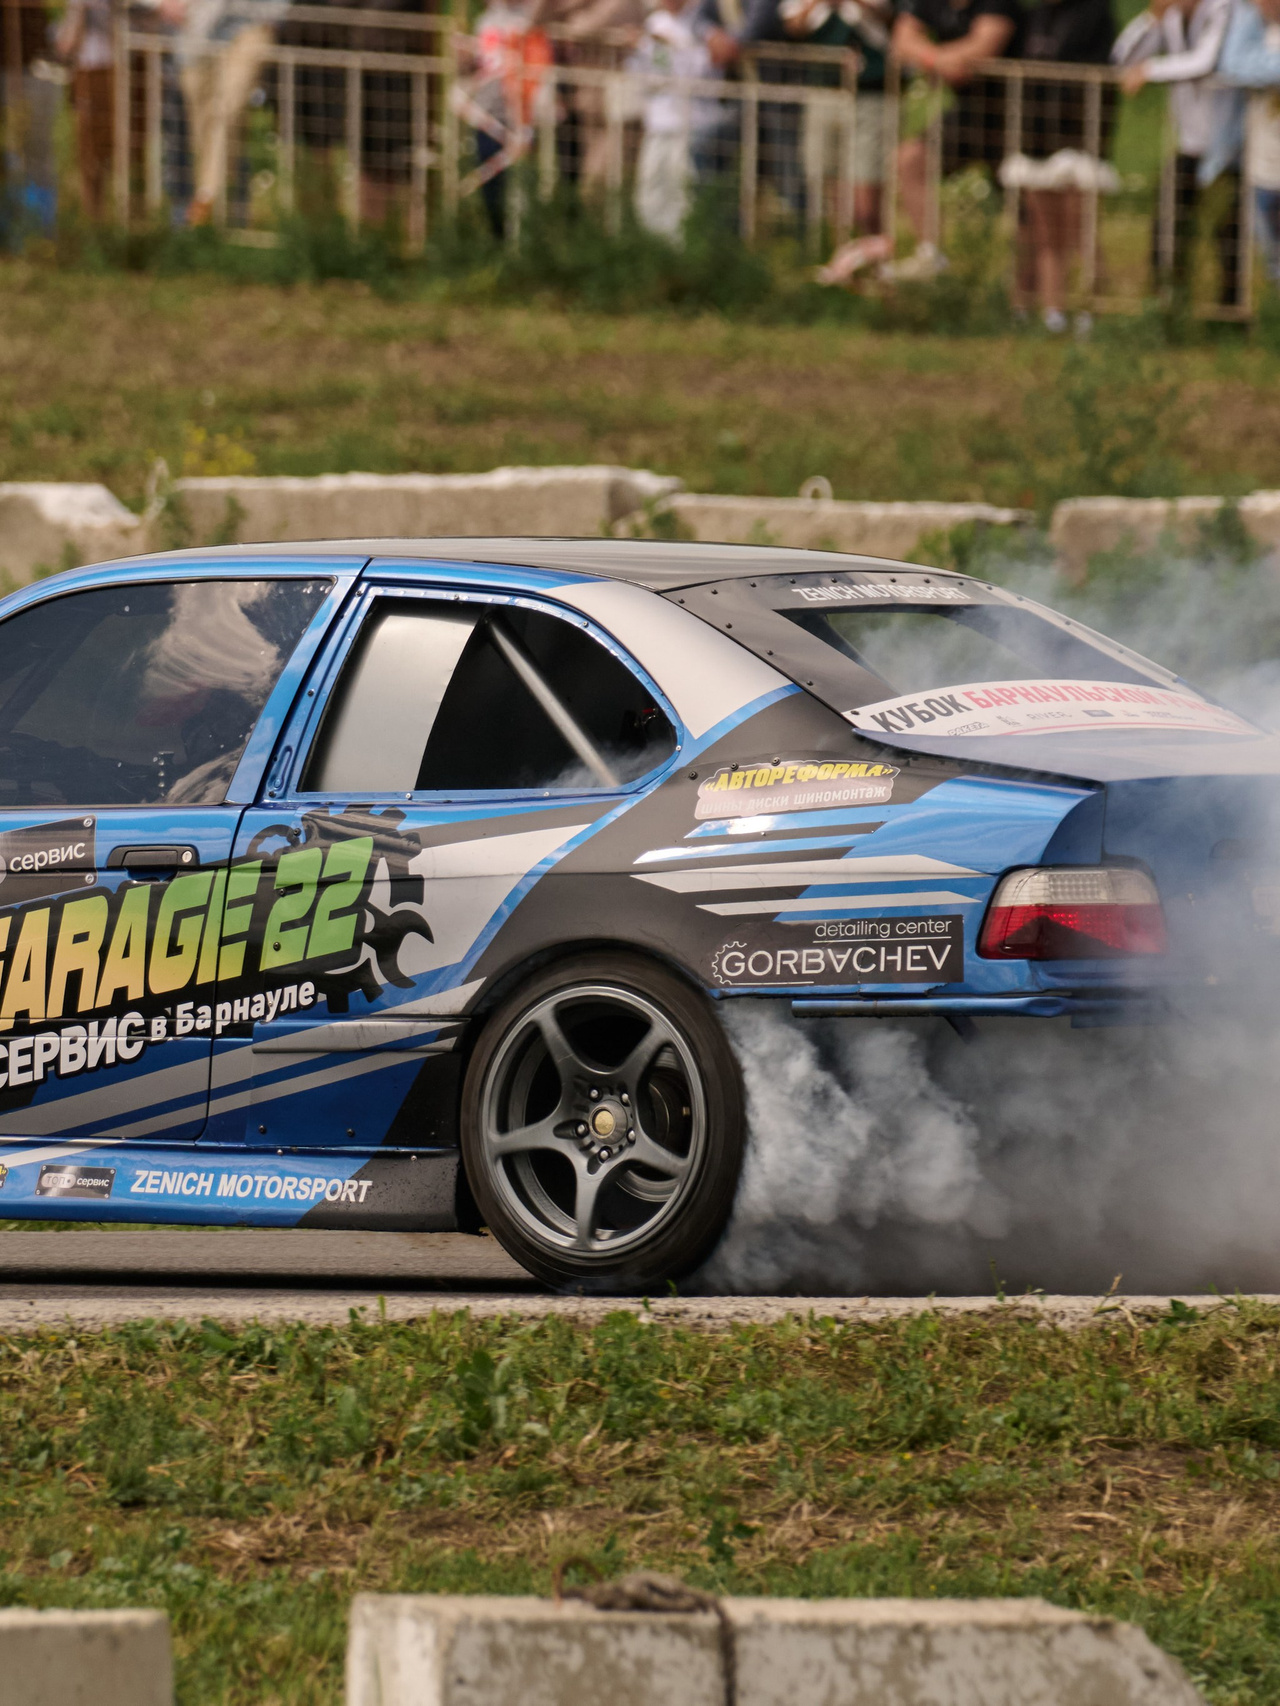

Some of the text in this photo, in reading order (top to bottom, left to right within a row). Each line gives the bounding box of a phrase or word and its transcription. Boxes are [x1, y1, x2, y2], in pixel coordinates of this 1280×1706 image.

[791, 583, 971, 601] ZENICH MOTORSPORT
[870, 694, 973, 733] КУБОК
[793, 785, 887, 806] шиномонтаж
[9, 842, 86, 872] сервис
[258, 835, 374, 973] 22
[814, 918, 952, 938] detailing center
[150, 1015, 167, 1042] в
[175, 980, 316, 1036] Барнауле
[46, 1175, 110, 1187] ТОП сервис
[130, 1170, 373, 1203] ZENICH MOTORSPORT
